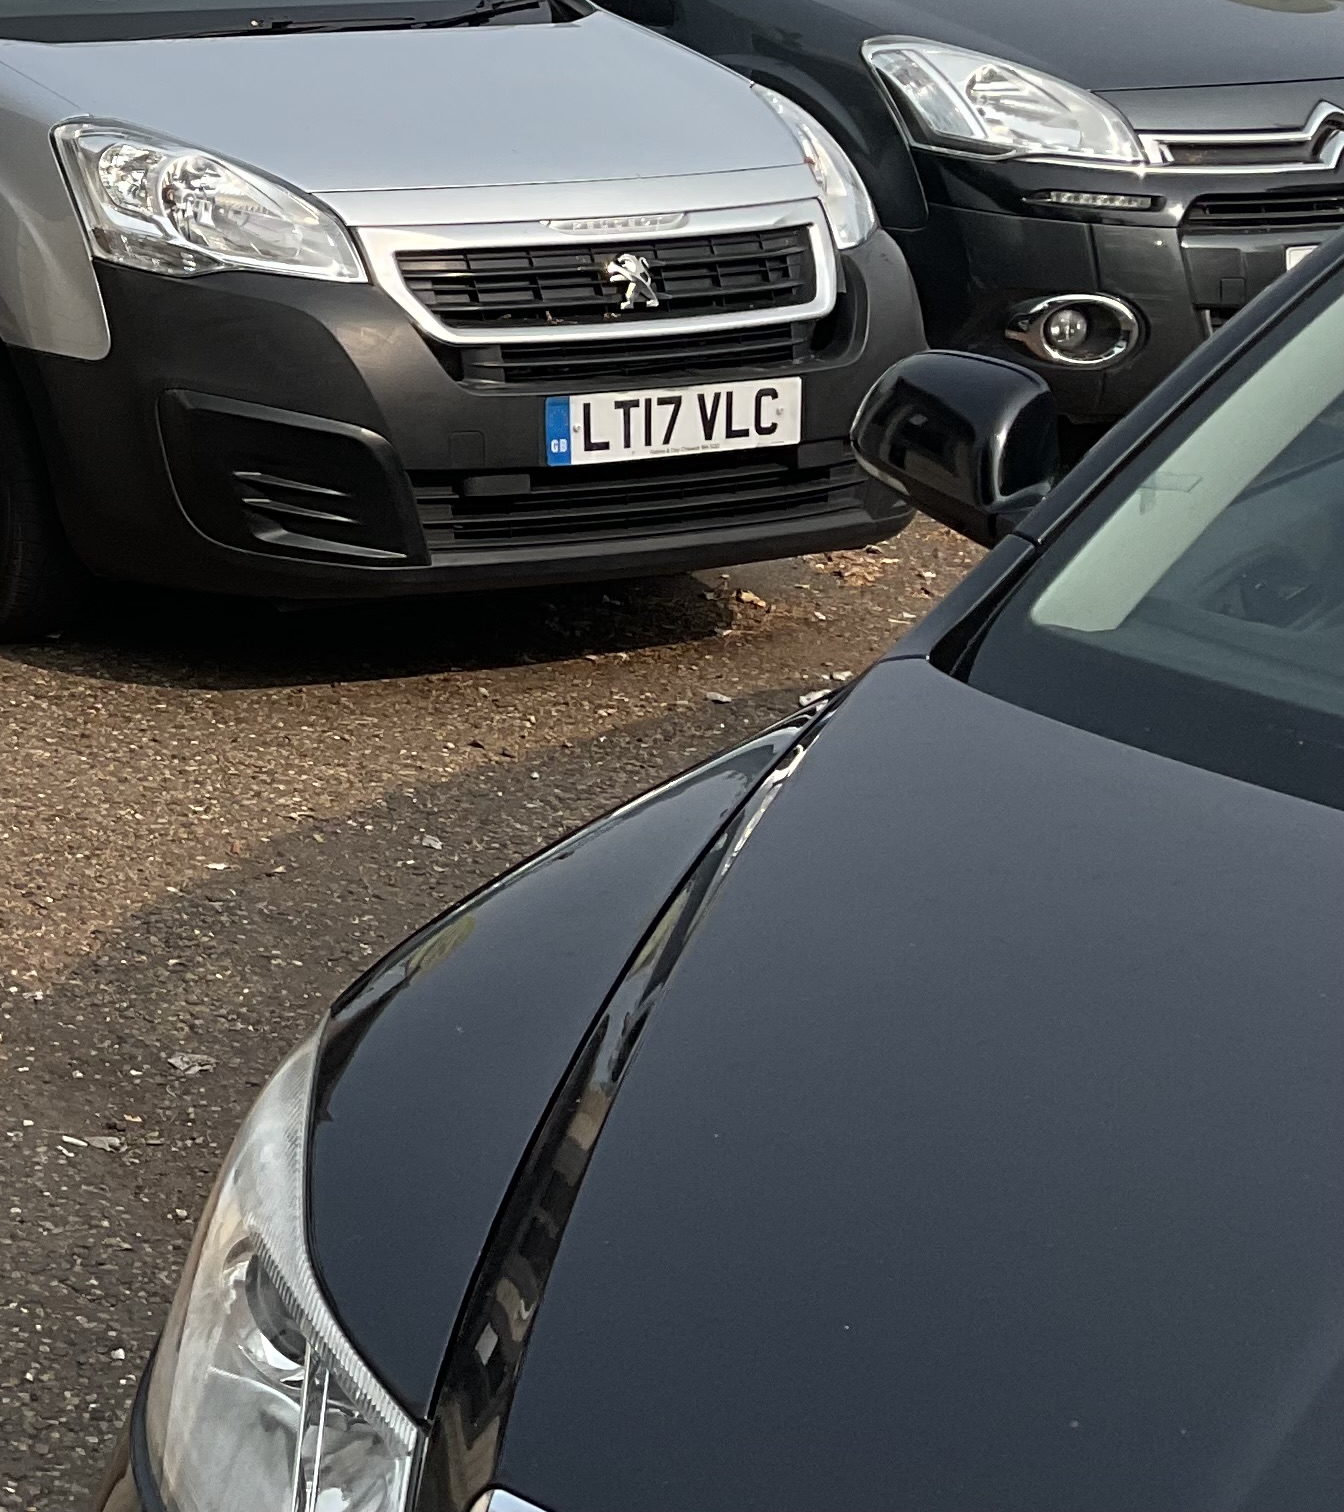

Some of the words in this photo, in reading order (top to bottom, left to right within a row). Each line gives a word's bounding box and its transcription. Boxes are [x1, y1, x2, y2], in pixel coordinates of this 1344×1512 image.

[583, 395, 682, 452] LT17
[697, 387, 779, 441] VLC
[550, 439, 568, 453] GB
